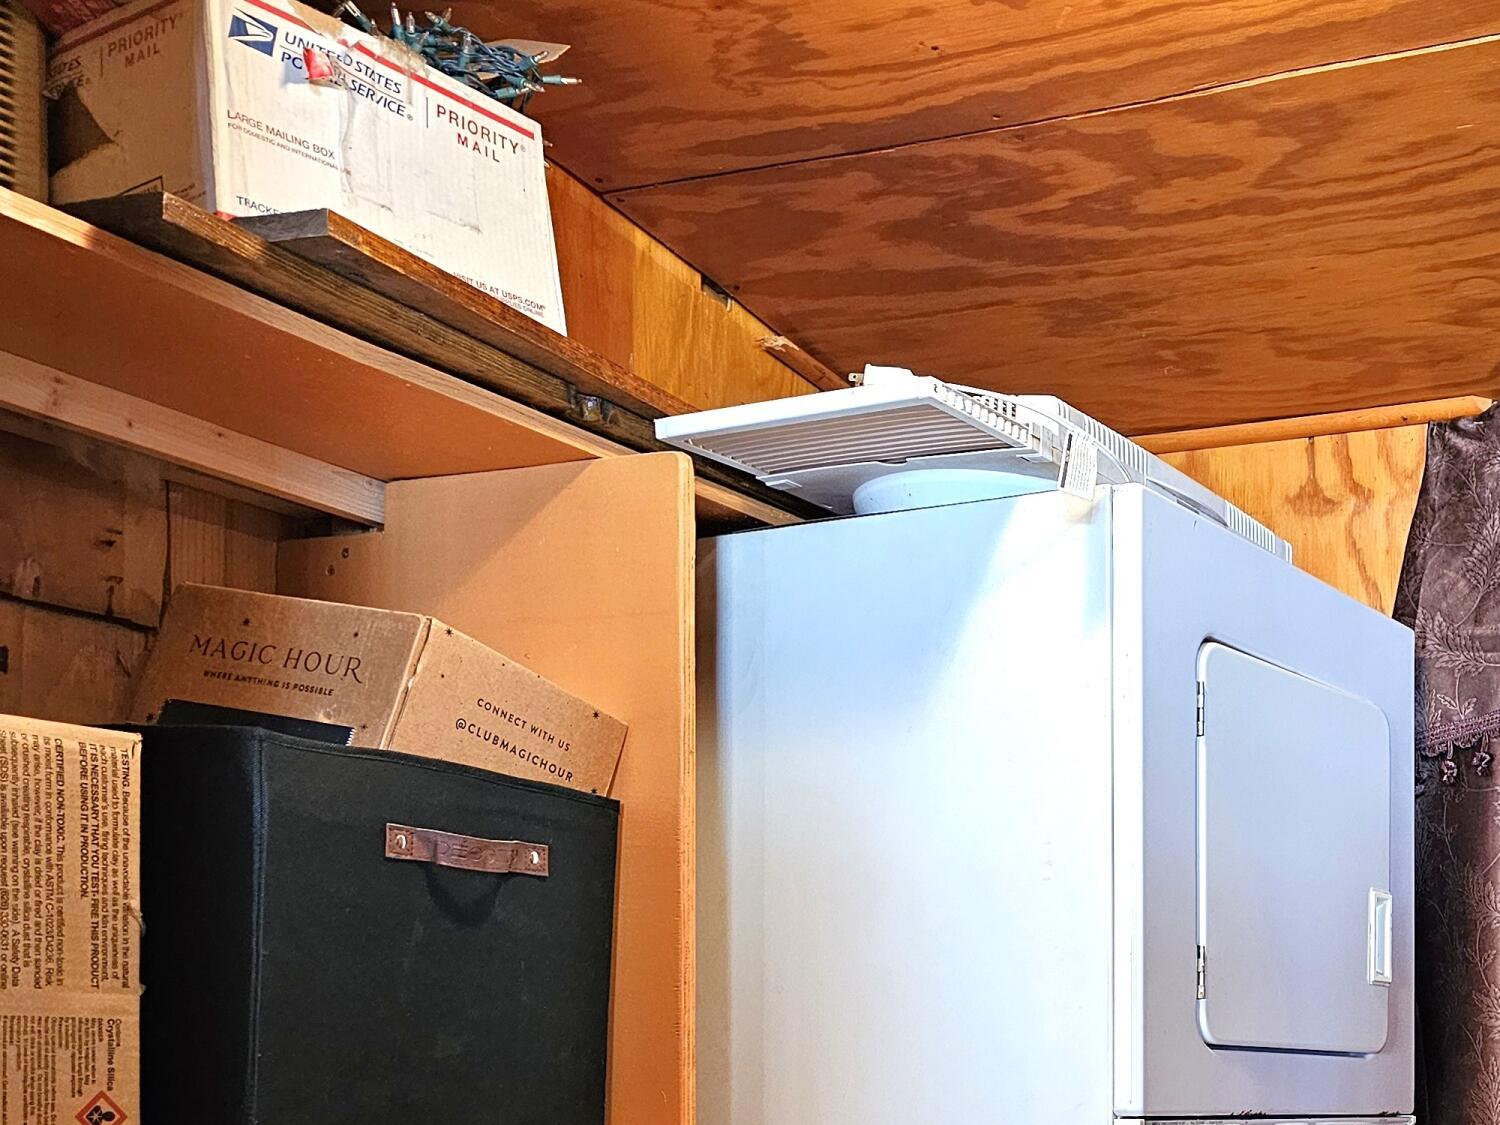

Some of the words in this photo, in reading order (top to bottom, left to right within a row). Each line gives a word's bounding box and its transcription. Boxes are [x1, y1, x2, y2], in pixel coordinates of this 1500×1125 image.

[107, 15, 178, 57] PRIORITY
[124, 44, 160, 68] MAIL
[355, 61, 402, 94] STATES
[227, 109, 263, 131] LARGE
[266, 124, 310, 150] MAILING
[312, 143, 336, 159] BOX
[457, 132, 500, 163] MAIL
[189, 634, 276, 665] MAGIC
[282, 647, 363, 684] HOUR
[203, 670, 232, 681] WHERE
[281, 681, 290, 689] IS
[292, 683, 334, 697] POSSIBLE
[477, 698, 527, 729] CONNECT
[530, 724, 555, 744] WITH
[558, 739, 571, 752] US
[55, 738, 65, 786] CERTIFIED
[79, 742, 89, 780] BEFORE
[455, 718, 573, 782] @CLUBMAGICHOUR
[120, 749, 130, 789] TESTING.
[80, 782, 89, 811] USING
[91, 764, 100, 821] NECESSARY
[122, 791, 130, 825] Because
[56, 788, 65, 843] NON-TOXIC.
[91, 824, 100, 847] THAT
[122, 837, 130, 850] the
[56, 845, 65, 862] This
[91, 850, 100, 869] YOU
[55, 863, 65, 896] product
[122, 852, 130, 900] unavoidable
[56, 905, 65, 937] certified
[91, 898, 100, 919] FIRE
[91, 921, 100, 941] THIS
[56, 939, 65, 976] non-toxic
[91, 942, 100, 989] PRODUCT
[122, 946, 130, 959] the
[122, 961, 130, 988] natural
[106, 1018, 115, 1065] Crystalline
[107, 1067, 116, 1091] Silica
